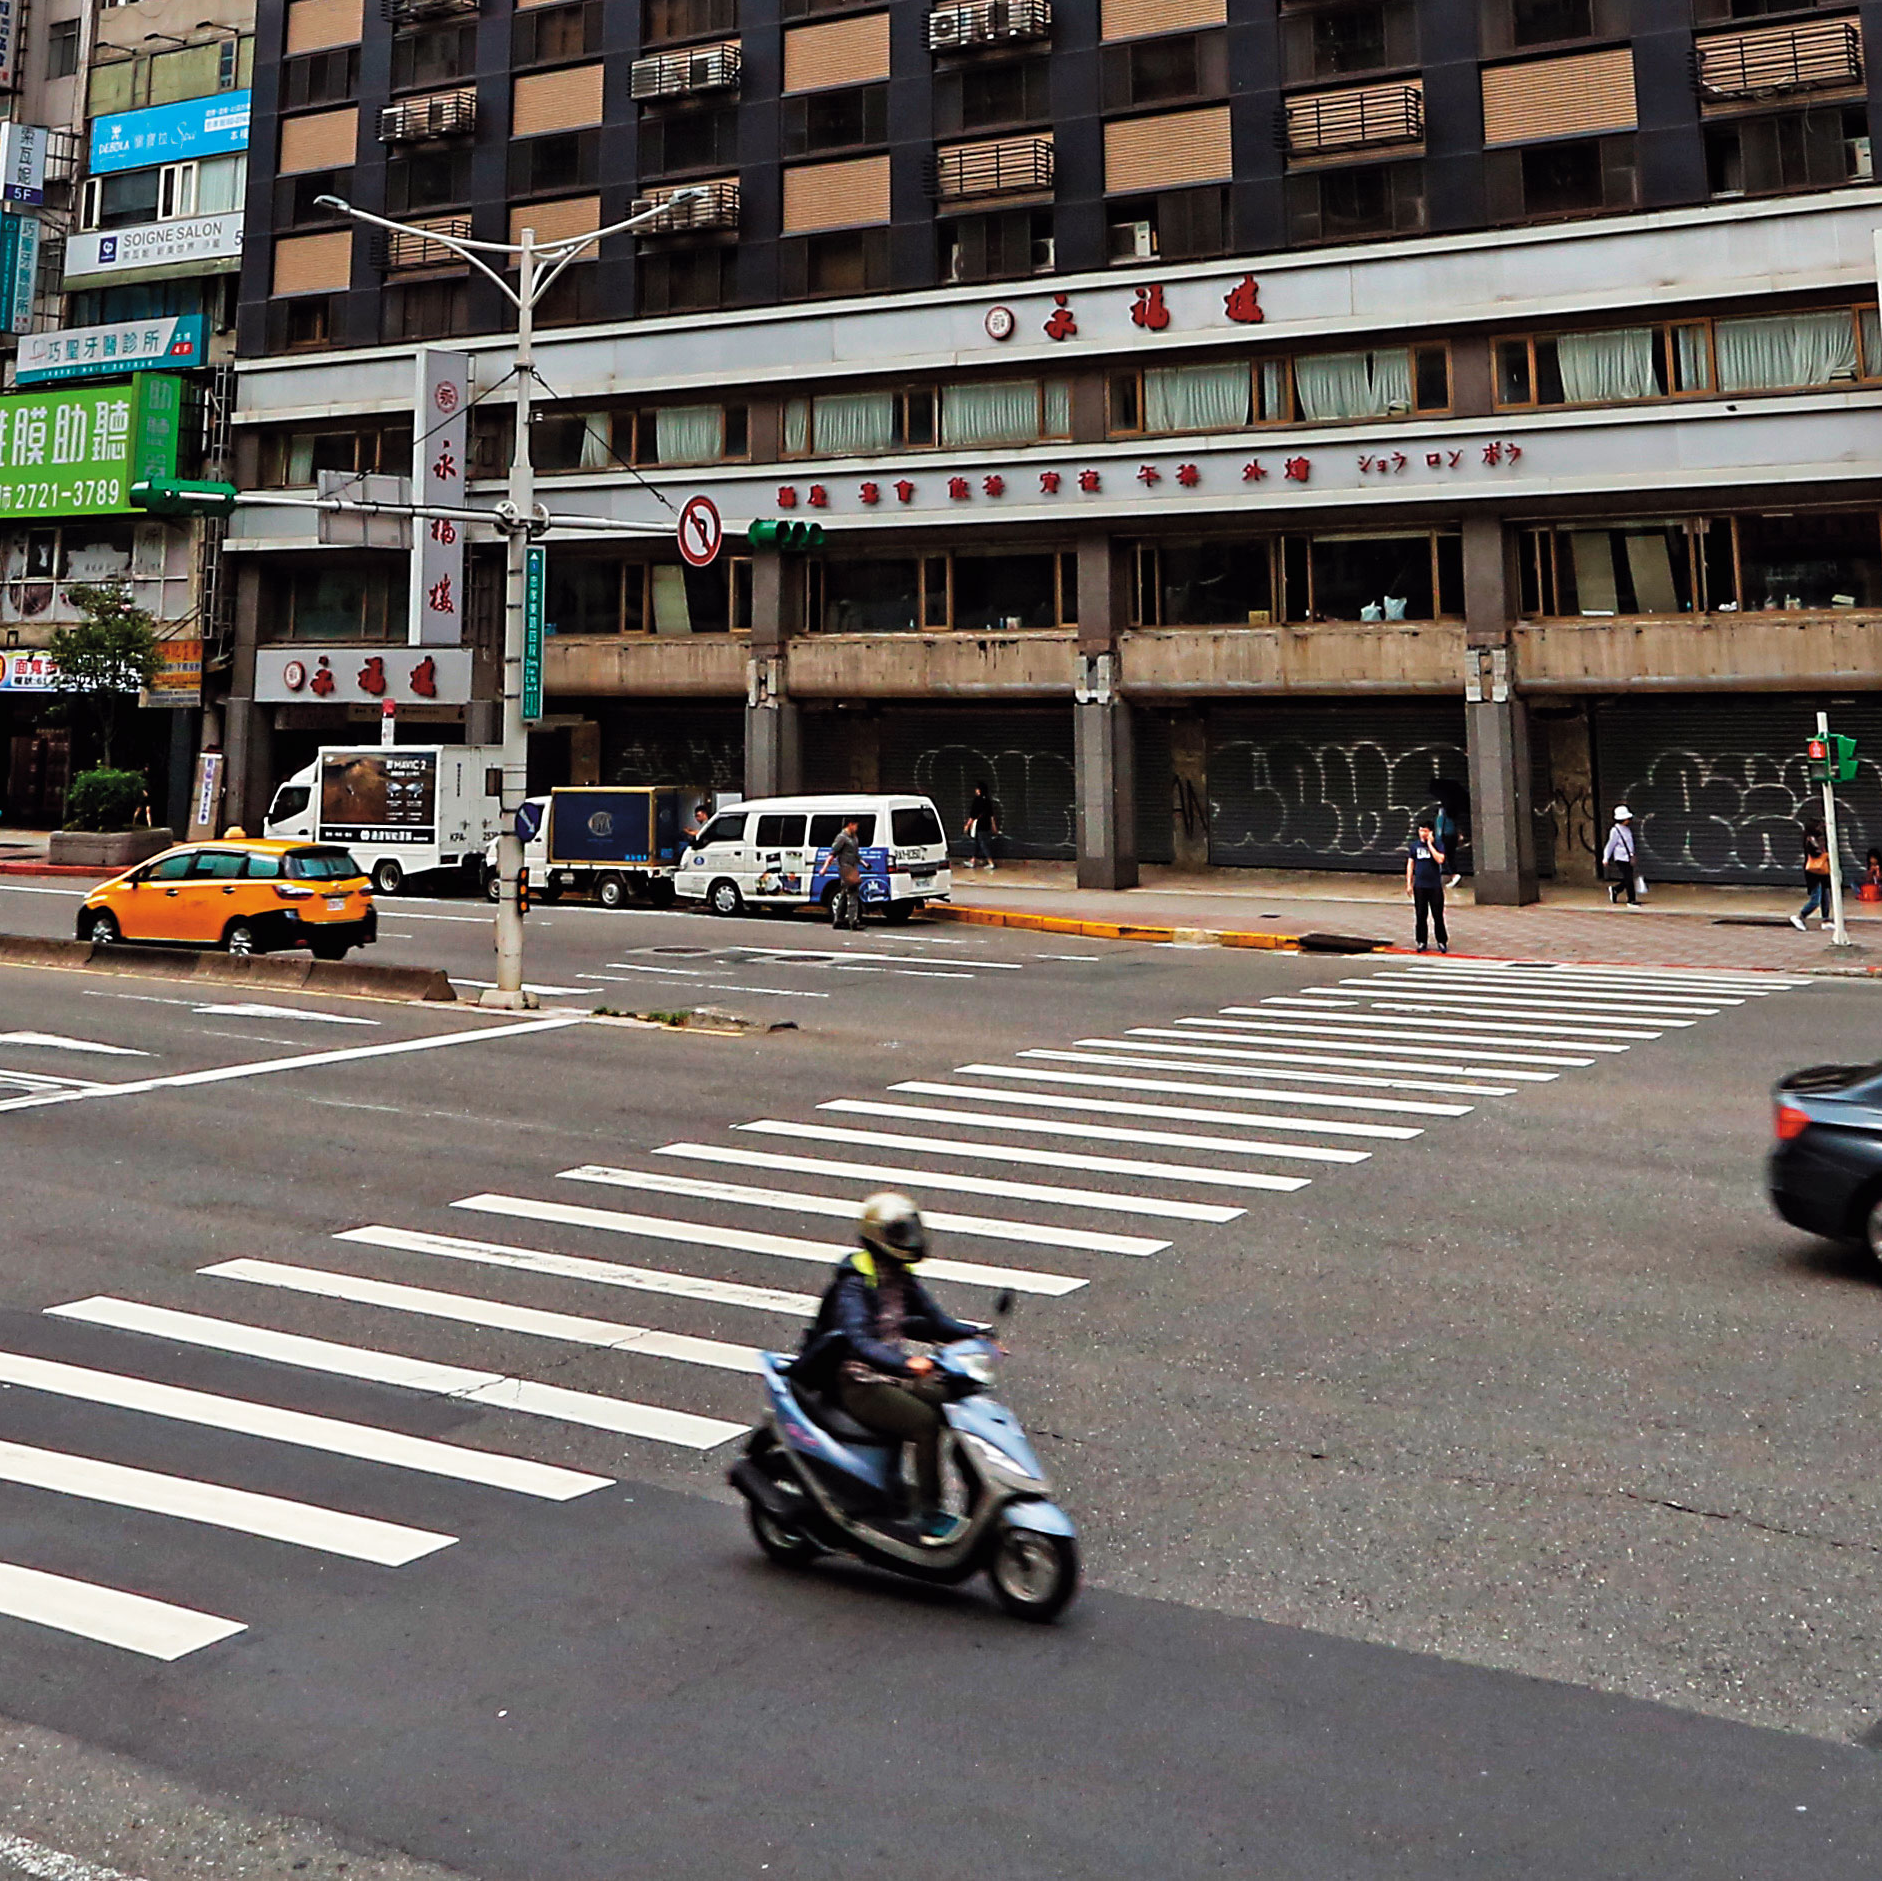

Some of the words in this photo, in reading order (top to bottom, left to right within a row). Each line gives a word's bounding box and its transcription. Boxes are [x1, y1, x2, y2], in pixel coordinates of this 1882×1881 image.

[13, 187, 33, 200] 5F
[123, 228, 175, 248] SOIGNE
[176, 221, 222, 241] SALON
[1044, 273, 1264, 340] 永福樓
[48, 329, 160, 362] 巧聖牙醫診所
[15, 478, 120, 510] 2721-3789
[428, 440, 459, 615] 永福樓
[309, 655, 437, 699] 永福樓
[394, 760, 419, 770] MAVIC
[420, 759, 427, 770] 2
